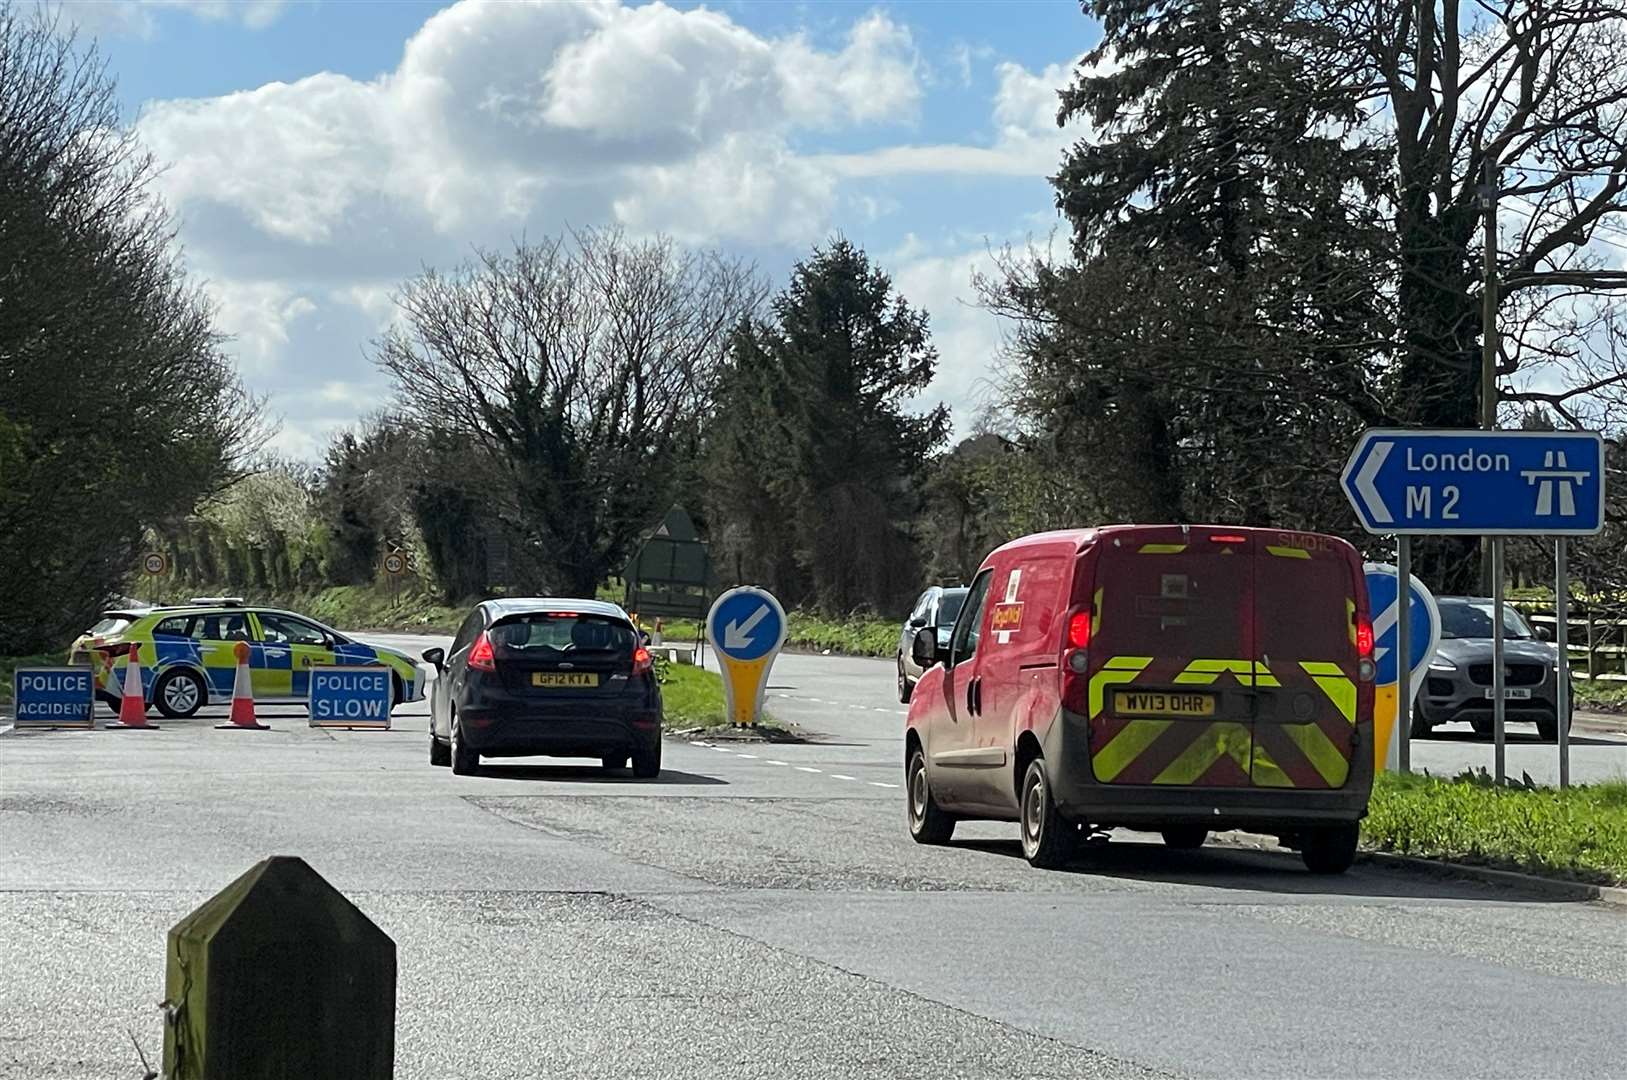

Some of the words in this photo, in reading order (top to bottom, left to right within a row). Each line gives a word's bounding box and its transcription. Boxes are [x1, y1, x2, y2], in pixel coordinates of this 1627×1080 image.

[1407, 447, 1510, 472] London
[21, 676, 87, 691] POLICE
[317, 676, 384, 691] POLICE
[540, 674, 566, 685] GF12
[568, 674, 591, 685] KTA
[18, 703, 91, 715] ACCIDENT
[317, 699, 383, 717] SLOW
[1126, 695, 1165, 711] WV13
